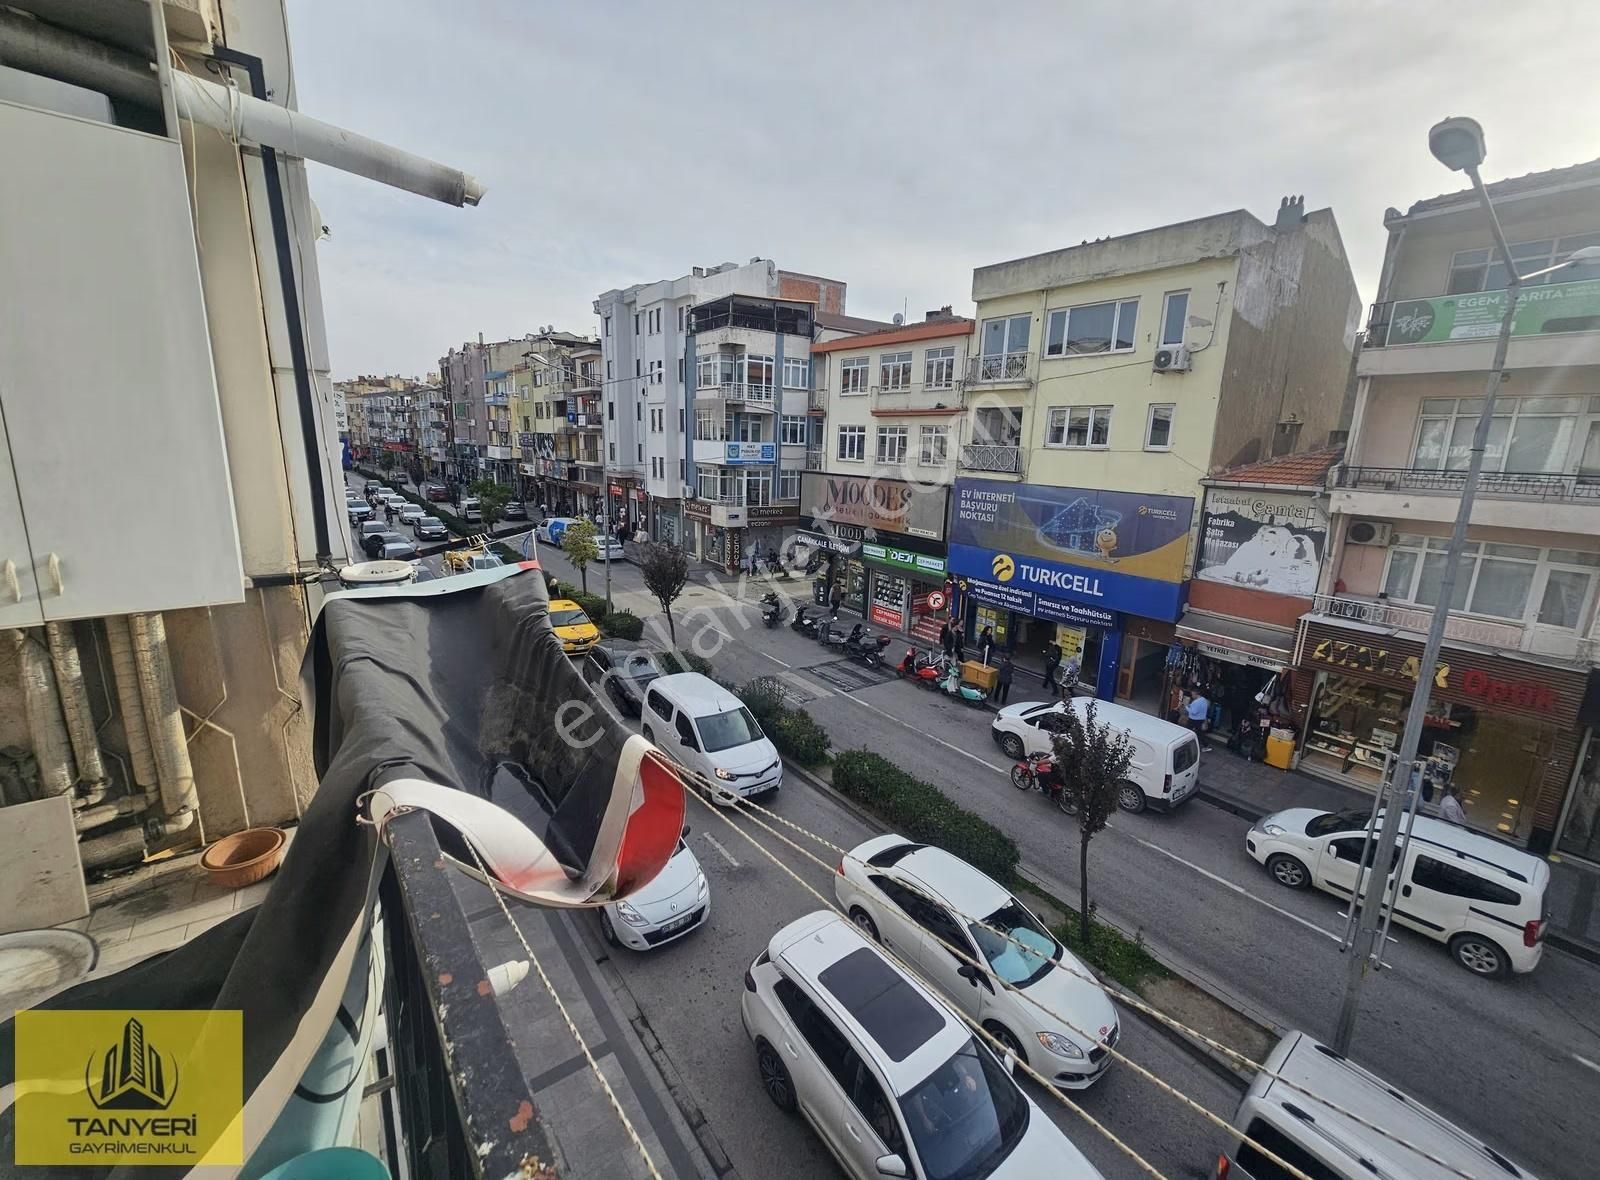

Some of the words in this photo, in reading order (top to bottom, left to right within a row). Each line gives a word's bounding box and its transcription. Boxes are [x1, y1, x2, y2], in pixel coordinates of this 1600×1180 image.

[1457, 296, 1500, 308] EGEM
[961, 489, 972, 499] EV
[973, 488, 1015, 503] İNTERNETİ
[759, 508, 783, 516] merkez
[960, 500, 998, 512] BAŞVURU
[959, 510, 995, 523] NOKTASI
[1207, 516, 1235, 527] Fabrika
[1206, 527, 1224, 537] Satış
[1204, 537, 1239, 549] Mağazası
[1020, 564, 1103, 597] TURKCELL
[1006, 595, 1022, 604] taksit
[1061, 604, 1070, 612] ve
